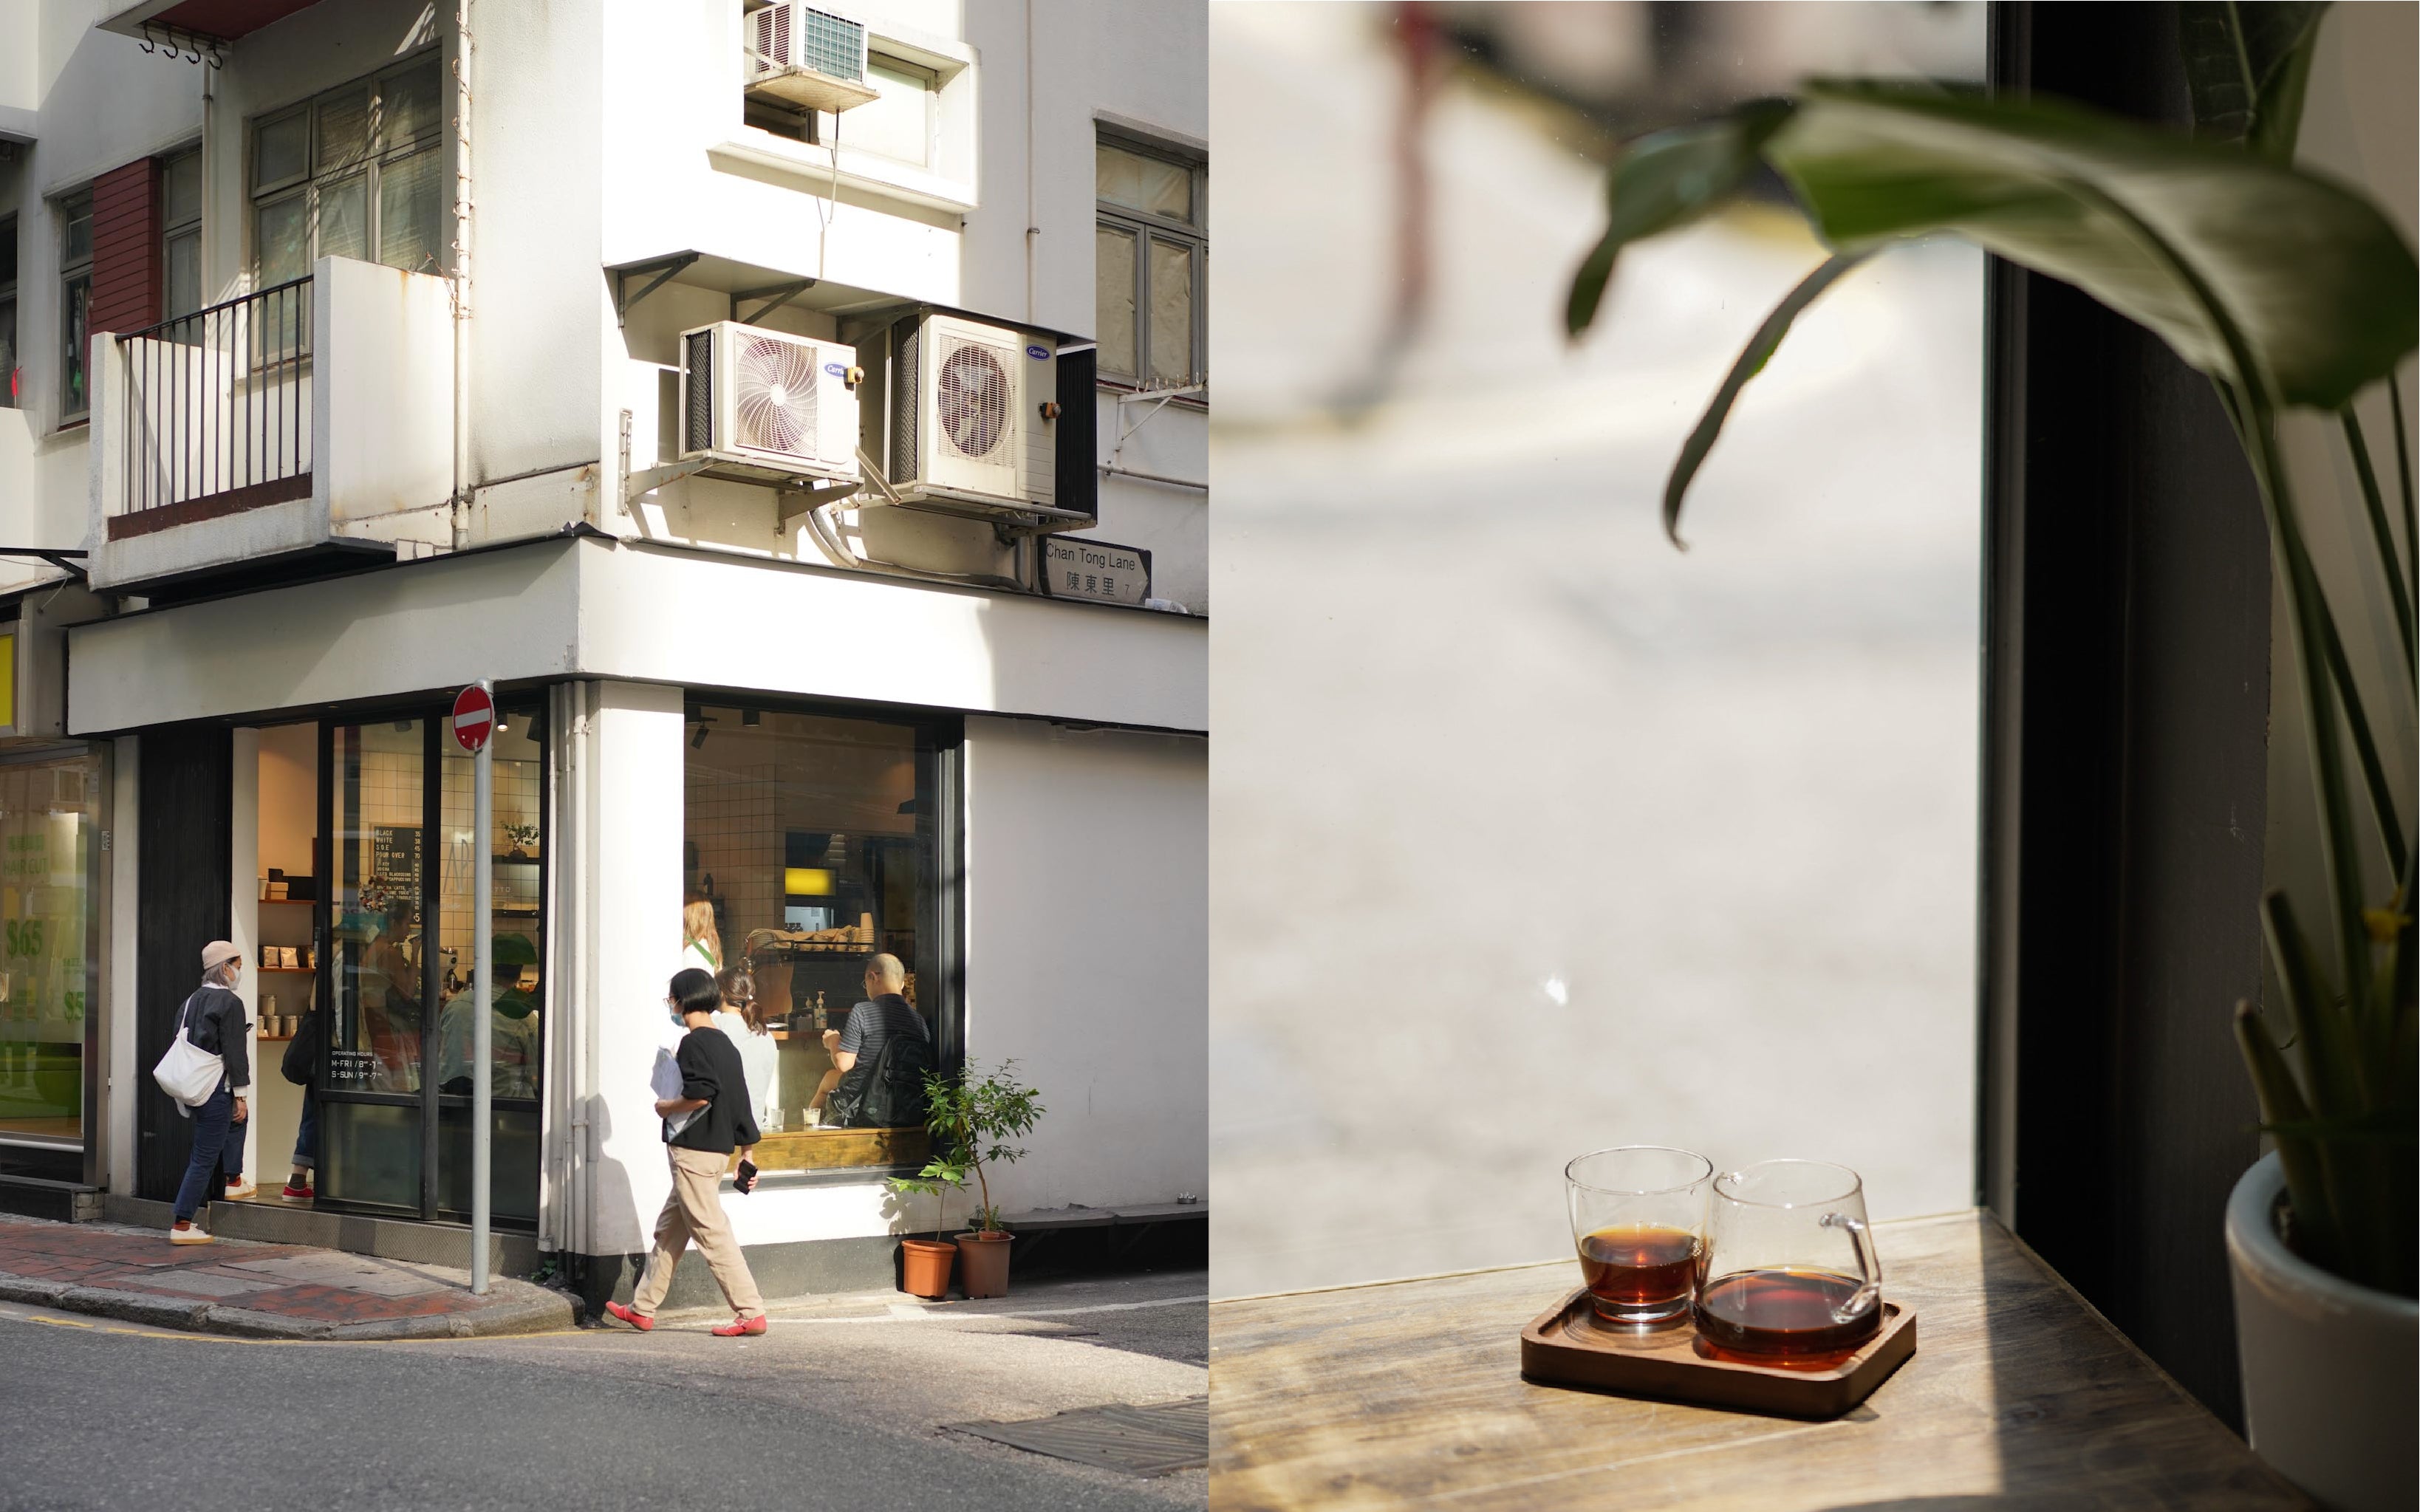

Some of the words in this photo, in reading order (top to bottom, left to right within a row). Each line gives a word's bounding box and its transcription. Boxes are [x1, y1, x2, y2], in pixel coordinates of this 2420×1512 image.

[1028, 347, 1047, 358] Carrier
[827, 365, 844, 374] Carri
[1046, 543, 1075, 561] Chan
[1079, 548, 1105, 569] Tong
[1110, 553, 1135, 571] Lane
[1067, 571, 1115, 596] 陳東里
[1124, 584, 1130, 595] 7
[29, 858, 48, 875] CUT
[7, 917, 42, 959] $65
[331, 1059, 352, 1067] M-FRI
[331, 1070, 353, 1078] S-SUN
